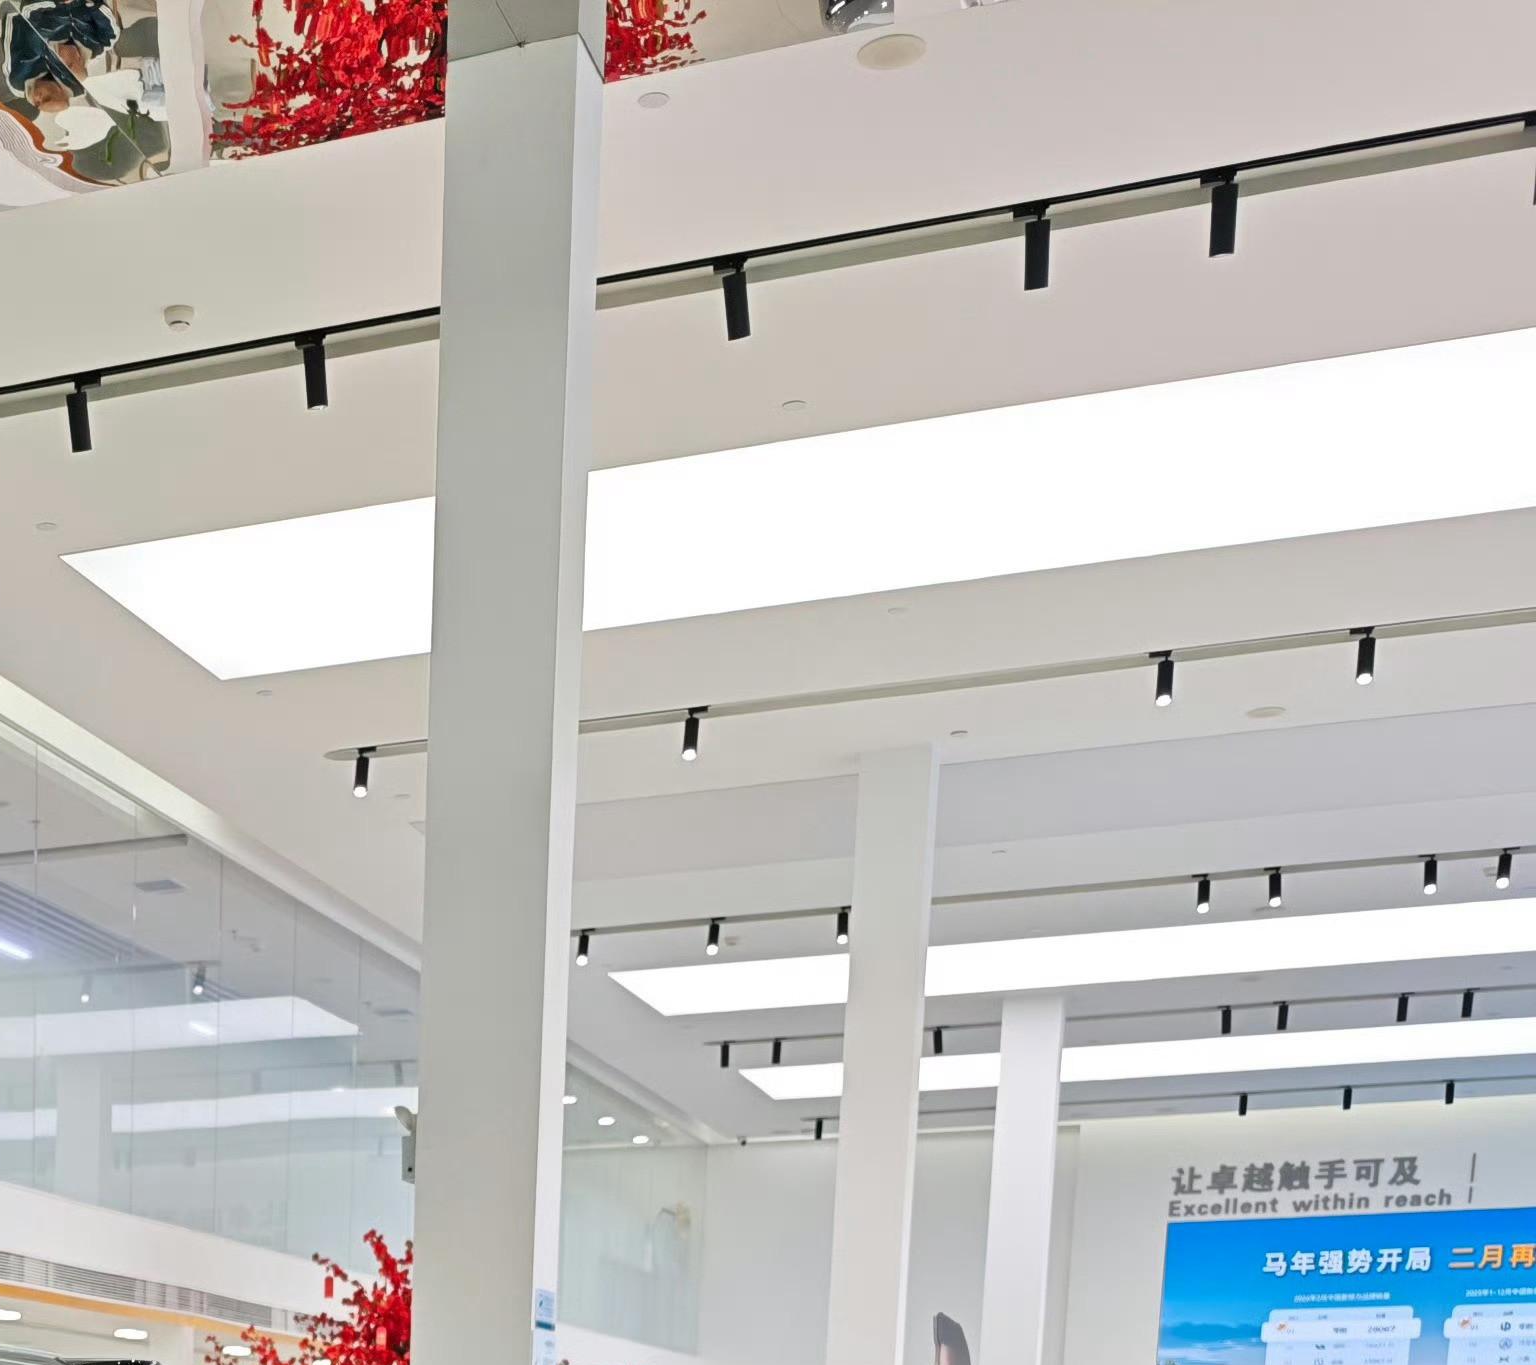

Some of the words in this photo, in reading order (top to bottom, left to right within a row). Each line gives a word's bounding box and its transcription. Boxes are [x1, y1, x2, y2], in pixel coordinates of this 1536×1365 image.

[1171, 1156, 1421, 1196] 让卓越触手可及
[1168, 1197, 1278, 1218] Excellent
[1292, 1194, 1370, 1213] within
[1384, 1189, 1452, 1208] reach
[1263, 1247, 1432, 1277] 马年强势开局
